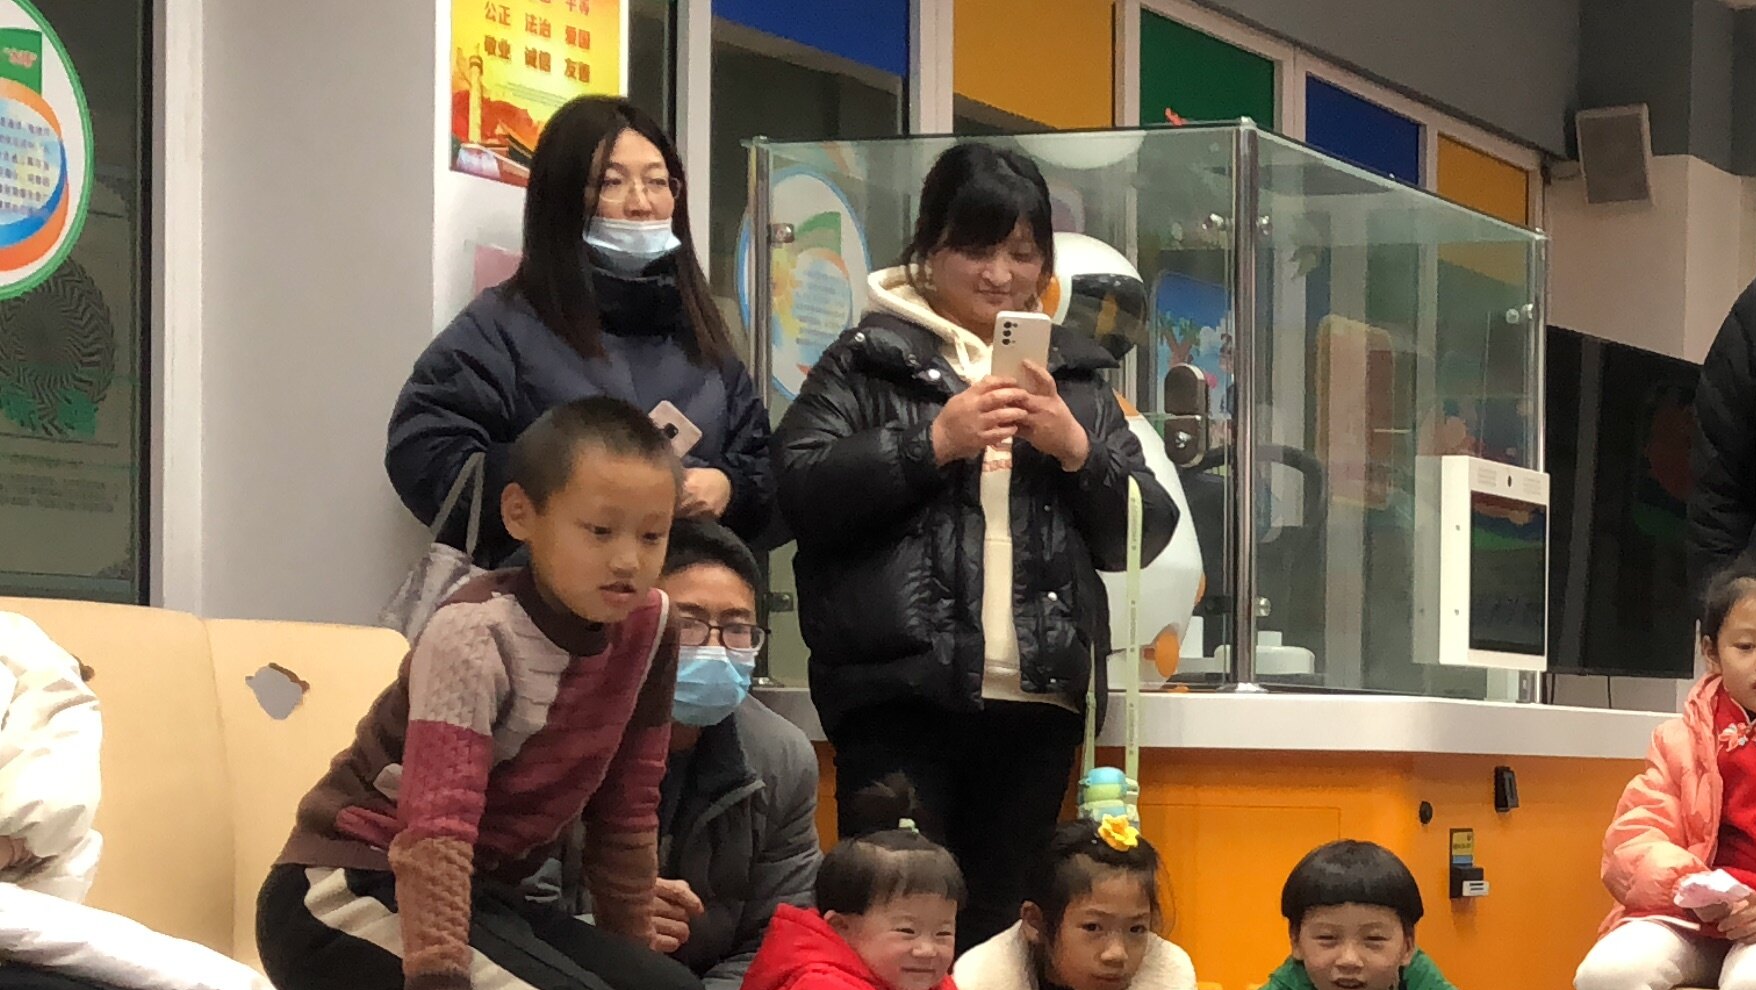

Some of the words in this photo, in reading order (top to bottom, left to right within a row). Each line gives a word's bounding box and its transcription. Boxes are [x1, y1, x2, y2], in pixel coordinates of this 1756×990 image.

[484, 1, 511, 26] 公正
[525, 12, 551, 39] 法治
[565, 25, 591, 50] 爱国
[484, 35, 511, 60] 敬业
[525, 46, 551, 73] 诚信
[564, 57, 590, 84] 友善
